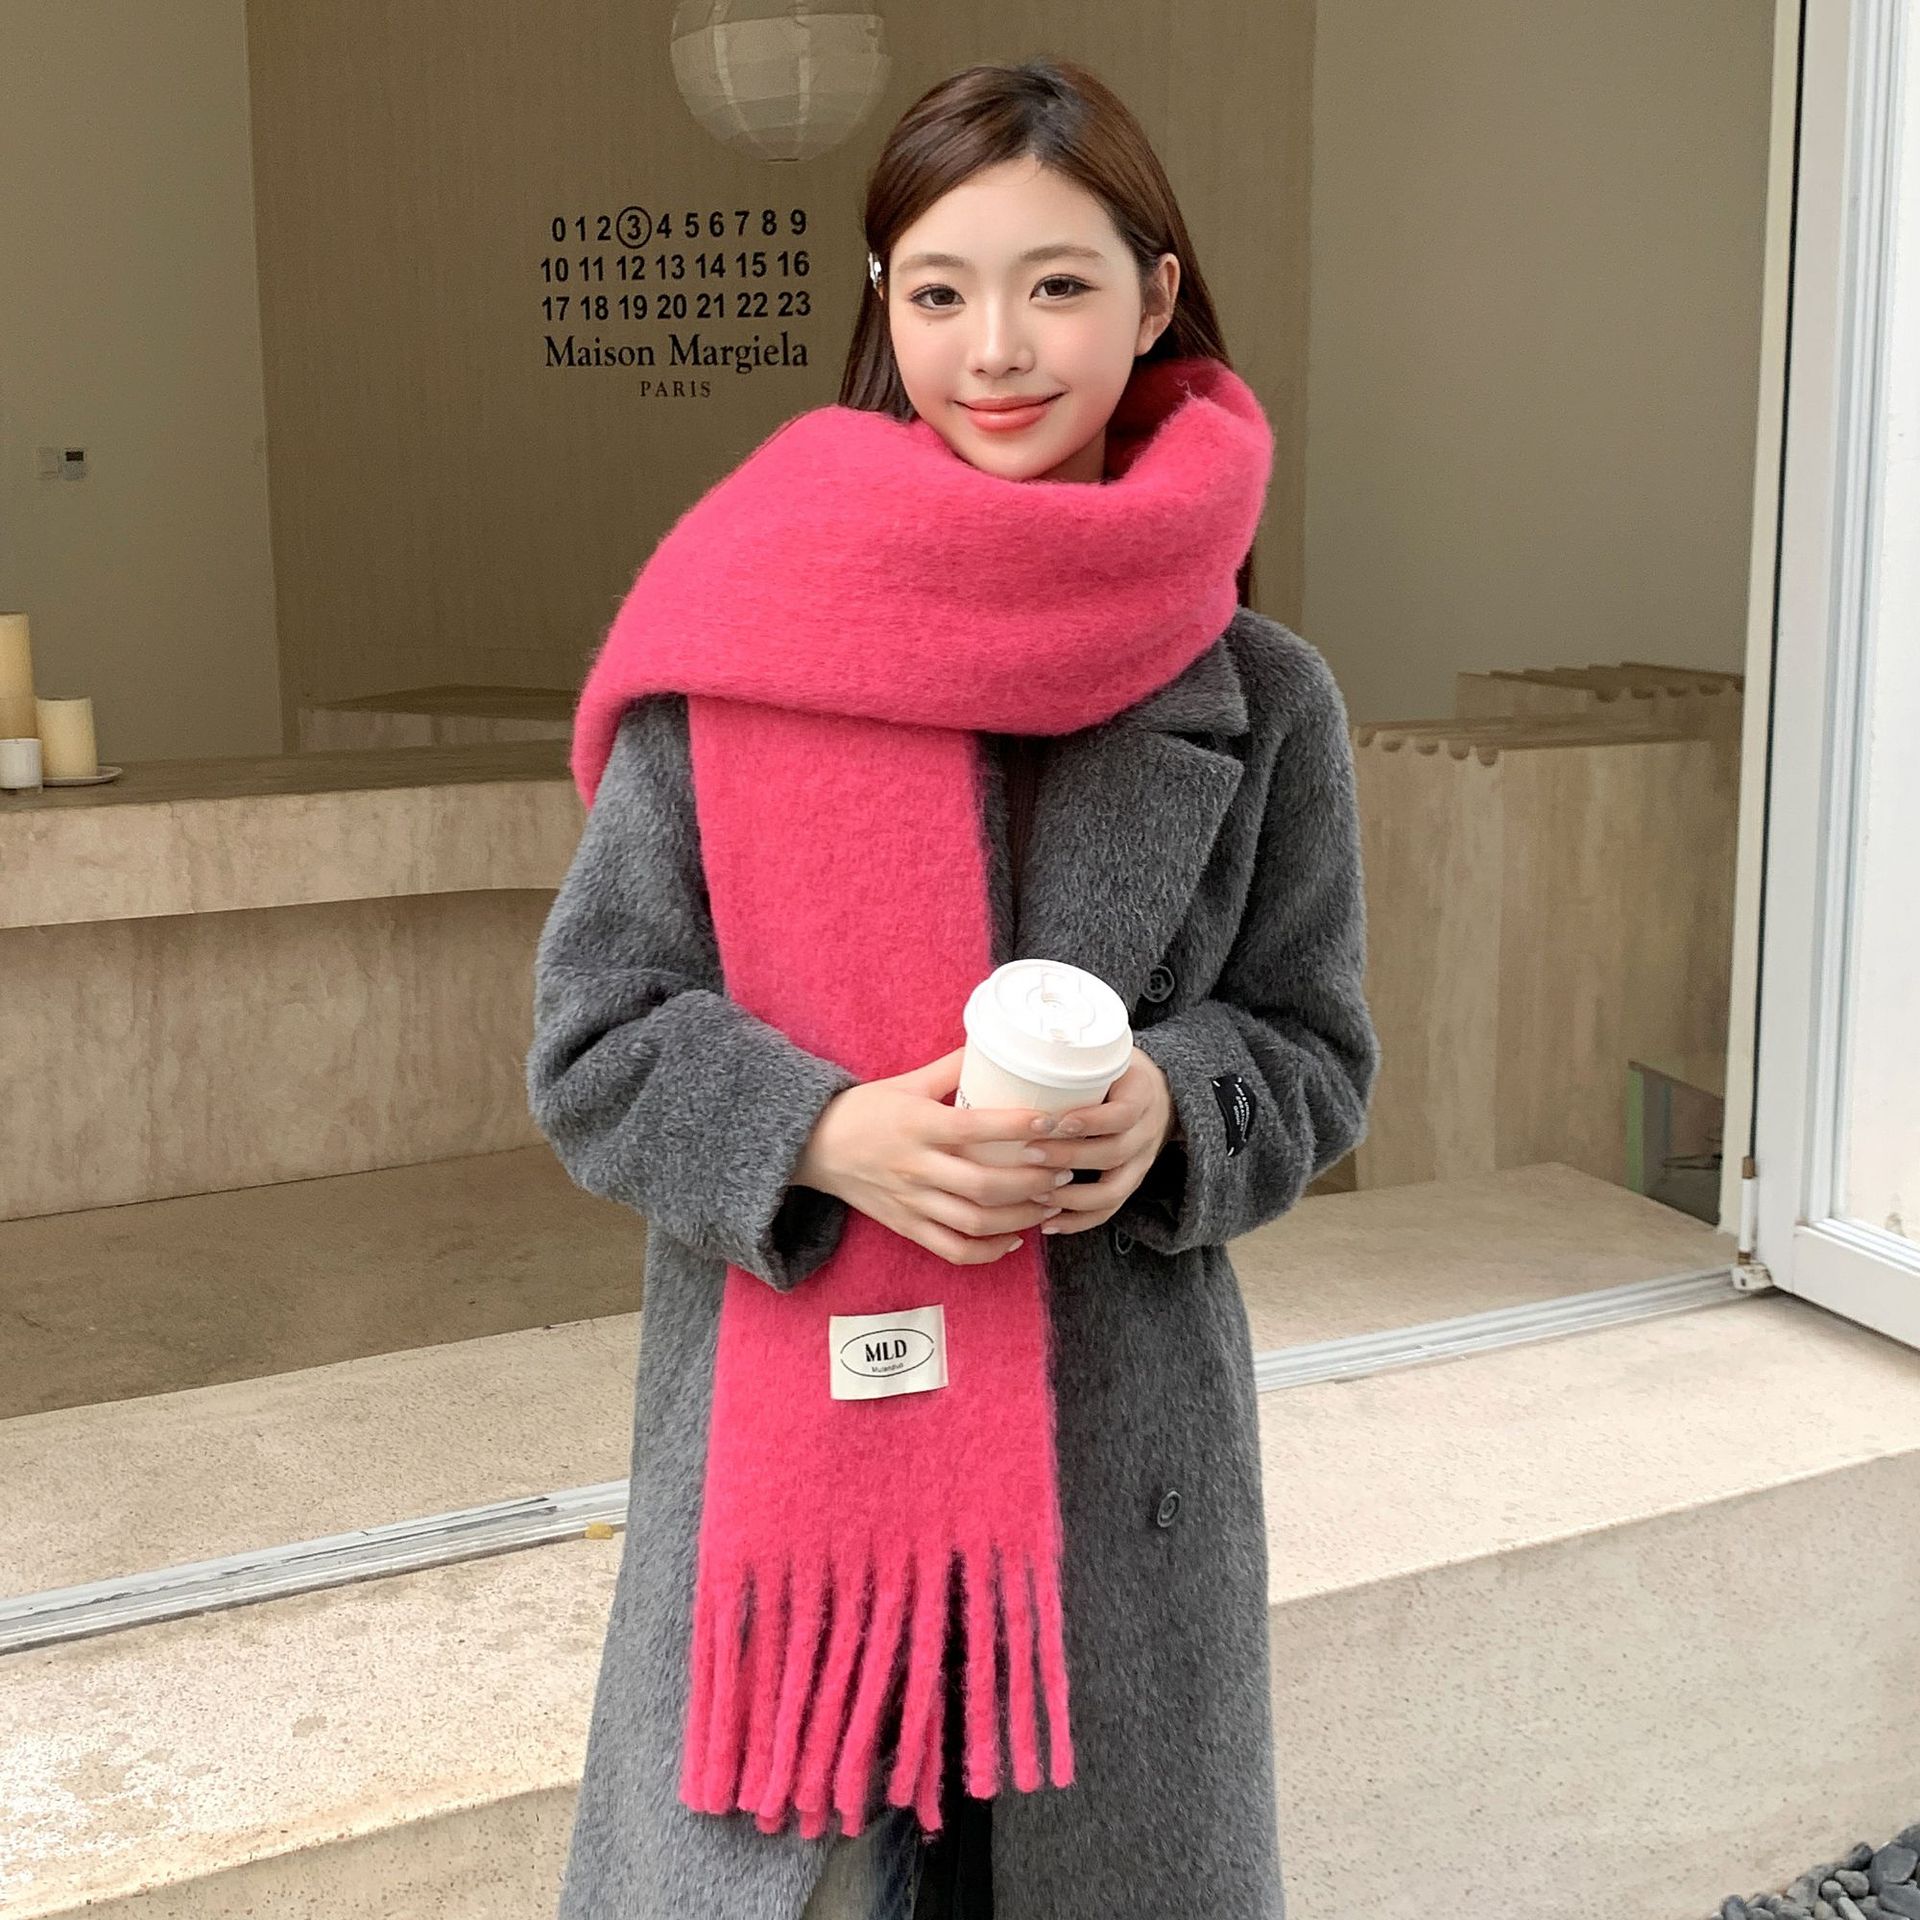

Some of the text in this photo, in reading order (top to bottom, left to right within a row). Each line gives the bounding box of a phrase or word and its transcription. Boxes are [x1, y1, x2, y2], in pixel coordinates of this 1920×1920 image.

[551, 208, 809, 243] 0 1 2 3 4 5 6 7 8 9
[540, 249, 811, 284] 10 11 12 13 14 15 16
[541, 290, 812, 322] 17 18 19 20 21 22 23
[543, 330, 809, 376] Maison Margiela
[639, 380, 712, 399] PARIS
[864, 1339, 908, 1363] MLD
